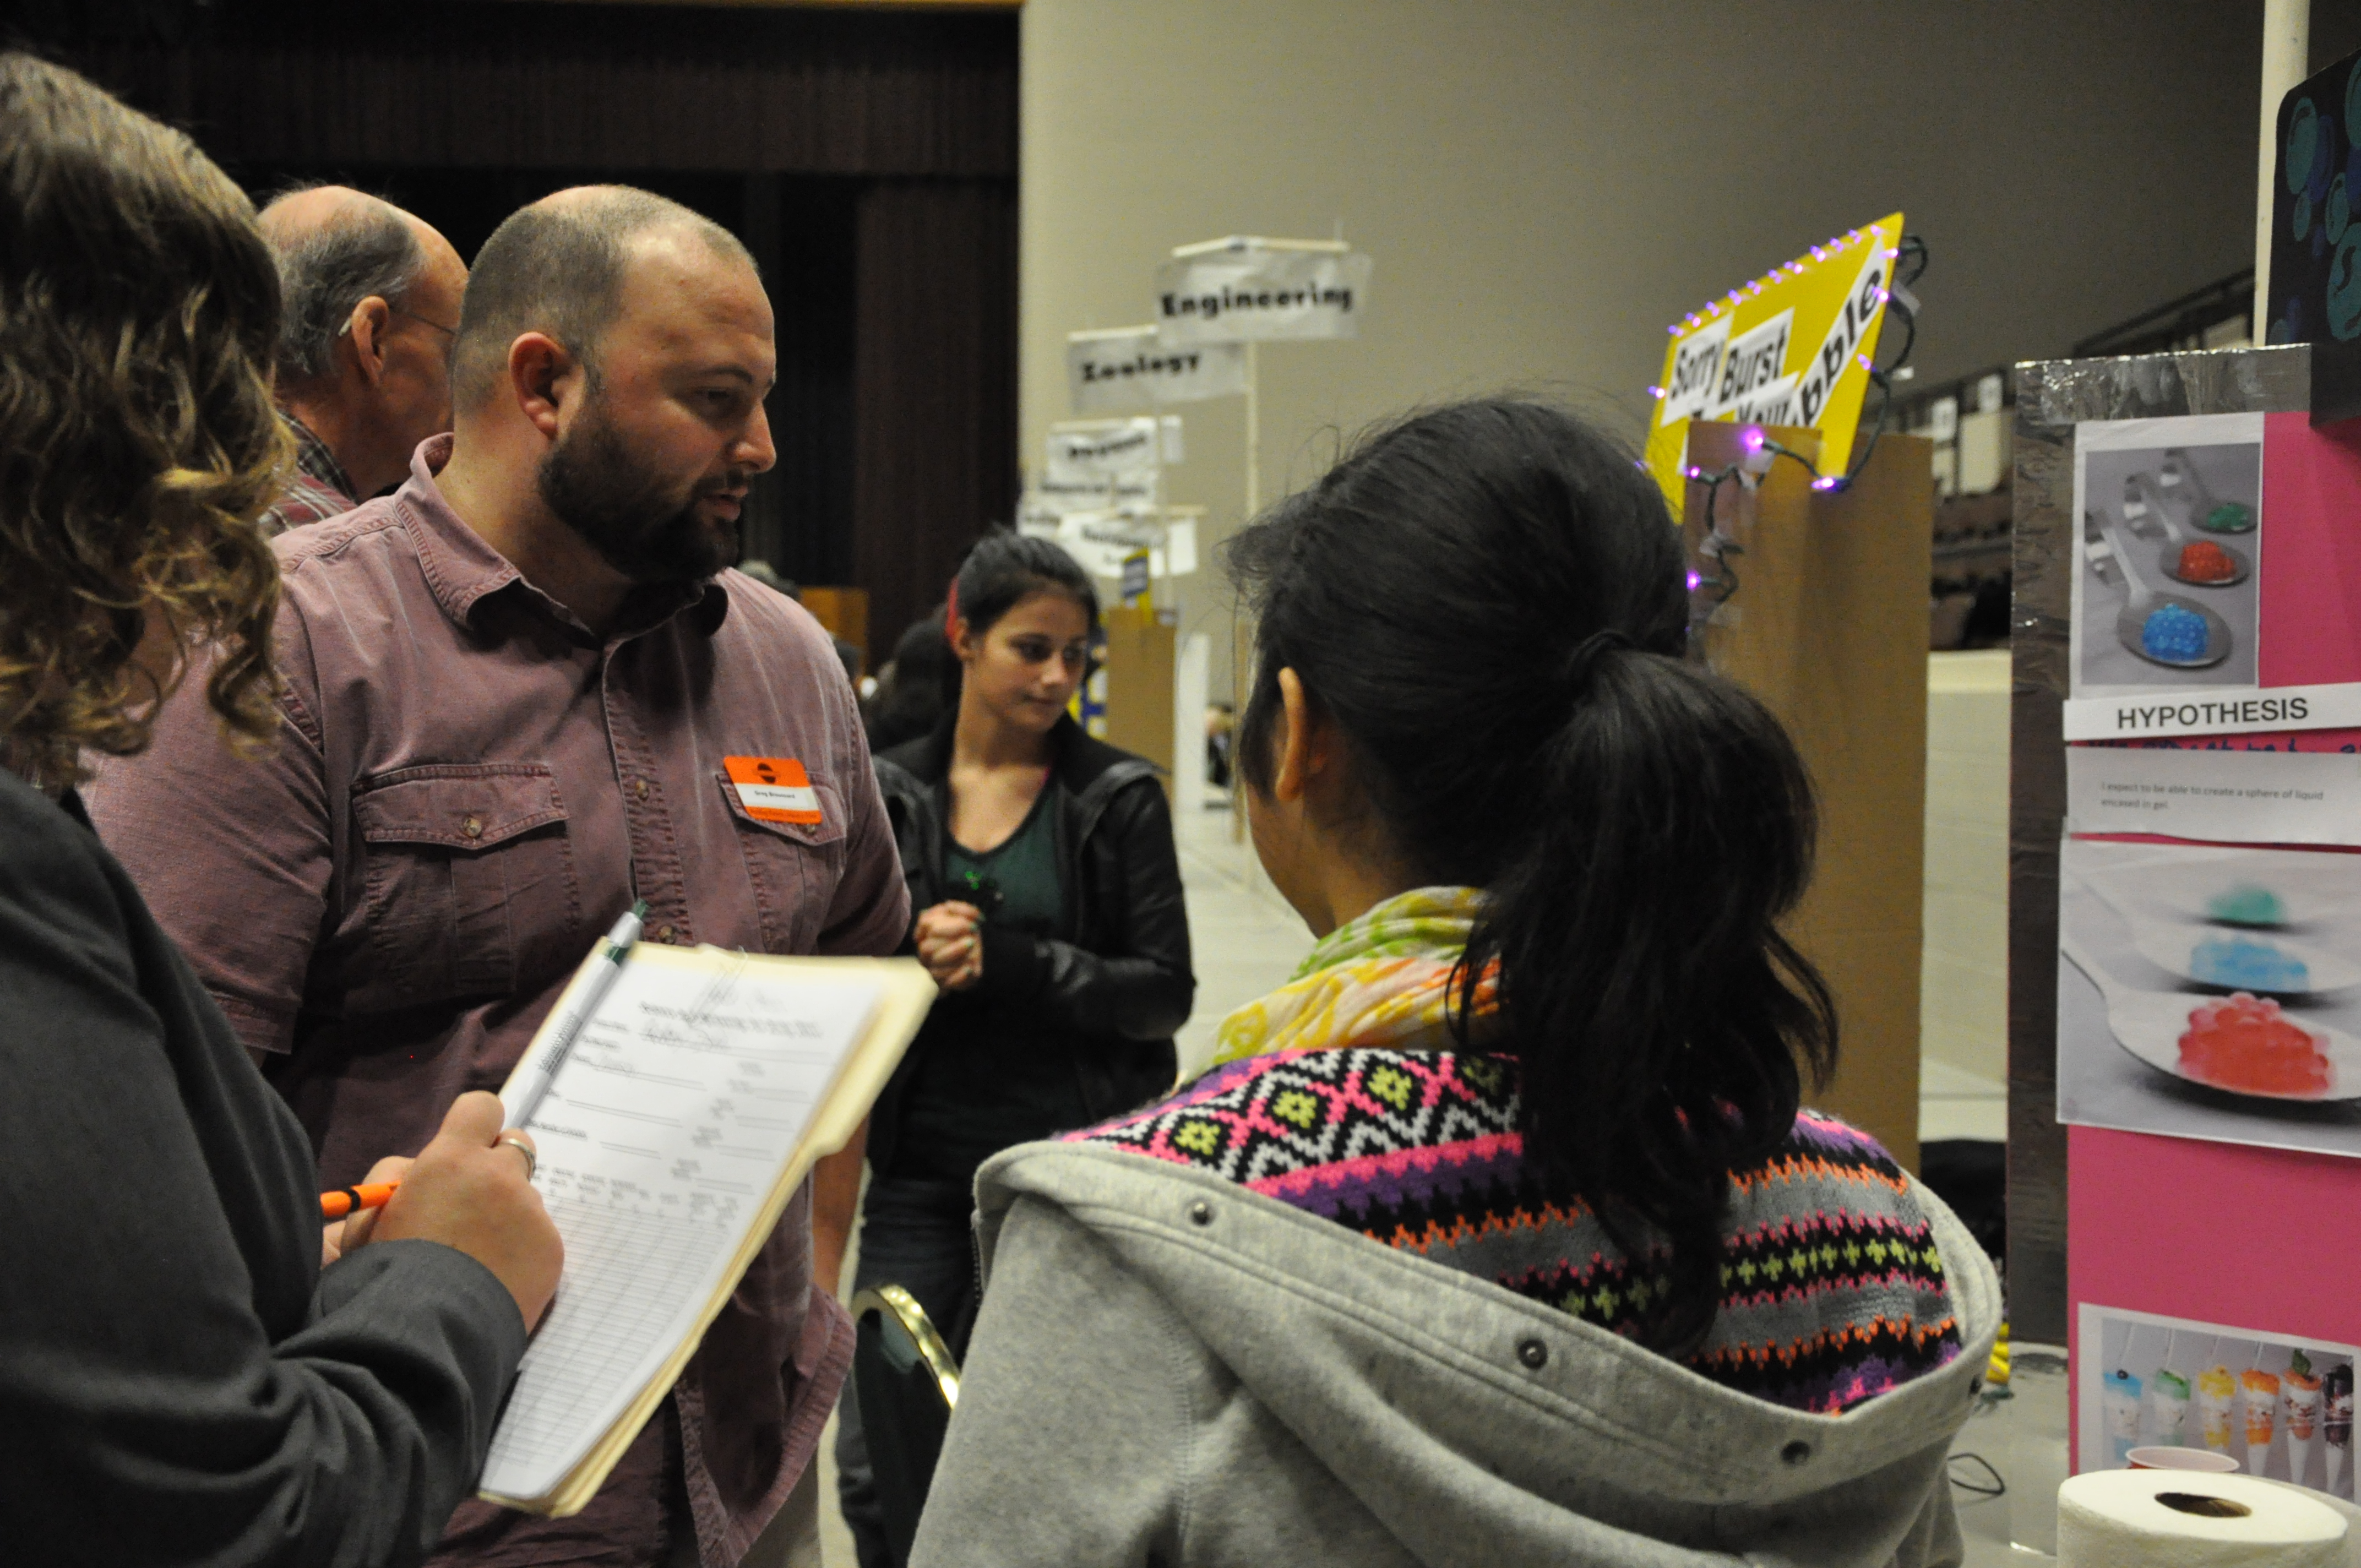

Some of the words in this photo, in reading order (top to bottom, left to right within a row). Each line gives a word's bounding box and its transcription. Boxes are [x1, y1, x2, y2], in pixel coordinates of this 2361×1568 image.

[1161, 281, 1353, 318] Engineering
[1081, 351, 1201, 384] Zoology
[1671, 337, 1725, 400] Sorry
[1718, 324, 1787, 405] Burst
[2117, 698, 2309, 730] HYPOTHESIS
[2107, 783, 2138, 793] expect
[2140, 784, 2152, 792] to
[2153, 784, 2165, 793] be
[2168, 785, 2188, 794] able
[2191, 786, 2201, 794] to
[2204, 787, 2235, 796] create
[2245, 788, 2280, 799] sphere
[2282, 790, 2293, 798] of
[2295, 790, 2324, 801] liquid
